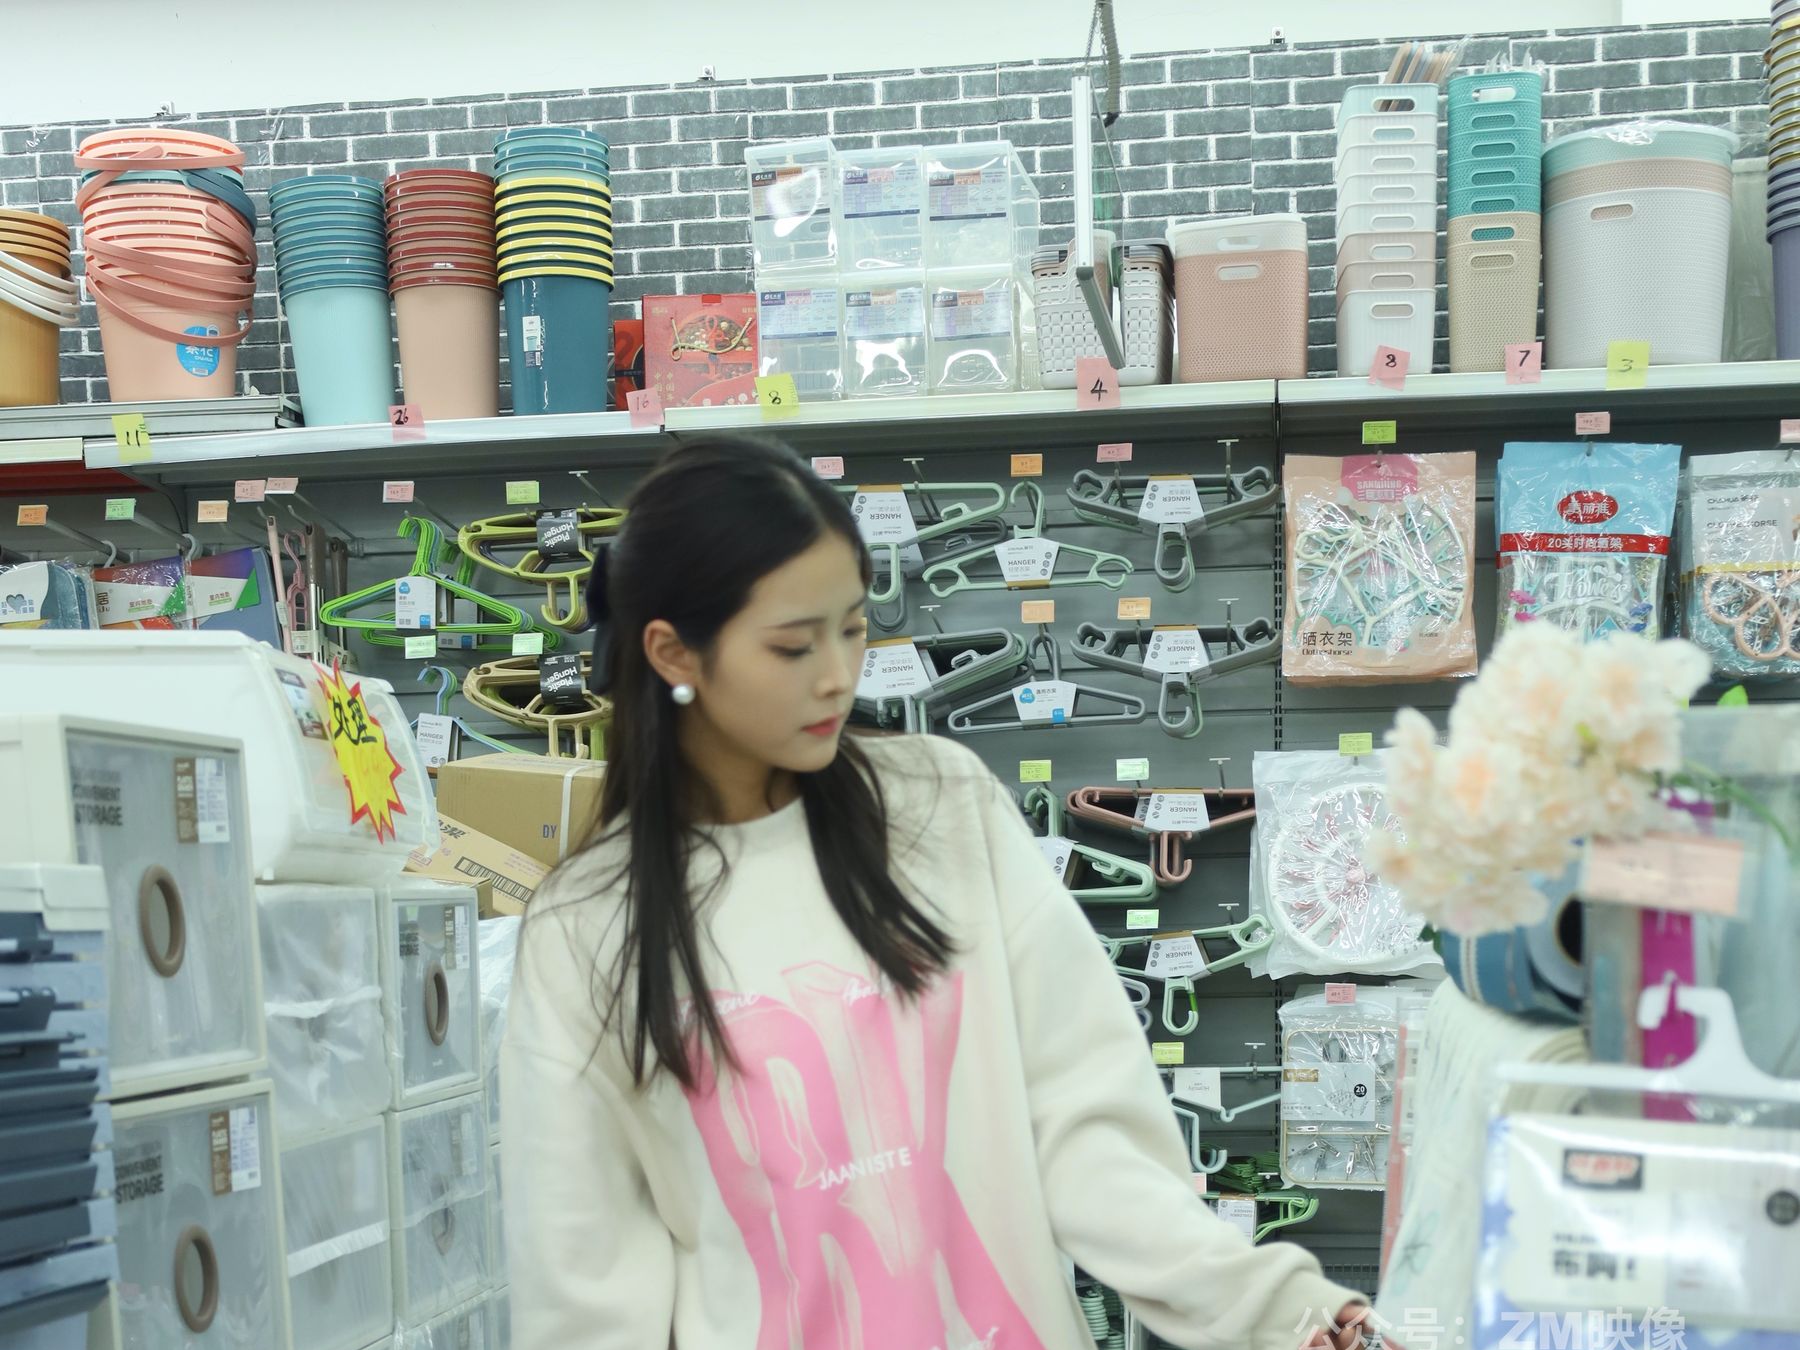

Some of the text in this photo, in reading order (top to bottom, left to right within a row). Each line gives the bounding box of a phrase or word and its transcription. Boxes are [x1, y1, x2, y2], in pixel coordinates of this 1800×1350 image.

[1385, 353, 1397, 369] 8
[1518, 350, 1530, 367] 7
[1621, 358, 1634, 373] 3
[1090, 377, 1108, 402] 4
[768, 390, 782, 405] 8
[394, 408, 409, 425] 26
[1162, 495, 1191, 503] HANGER
[869, 513, 902, 521] HANGER
[543, 521, 575, 539] Hanger
[544, 531, 571, 548] Plastic
[1007, 558, 1037, 567] HANGER
[1302, 631, 1353, 647] 晒衣架
[1166, 645, 1196, 653] HANGER
[545, 666, 578, 686] Hanger
[881, 665, 914, 674] HANGER
[547, 676, 574, 693] Plastic
[333, 695, 378, 745] 处理
[419, 731, 444, 740] HANGER
[542, 824, 557, 838] DY
[1165, 950, 1193, 959] HANGER
[1355, 1085, 1365, 1093] 20
[819, 1146, 913, 1191] JAANISTE
